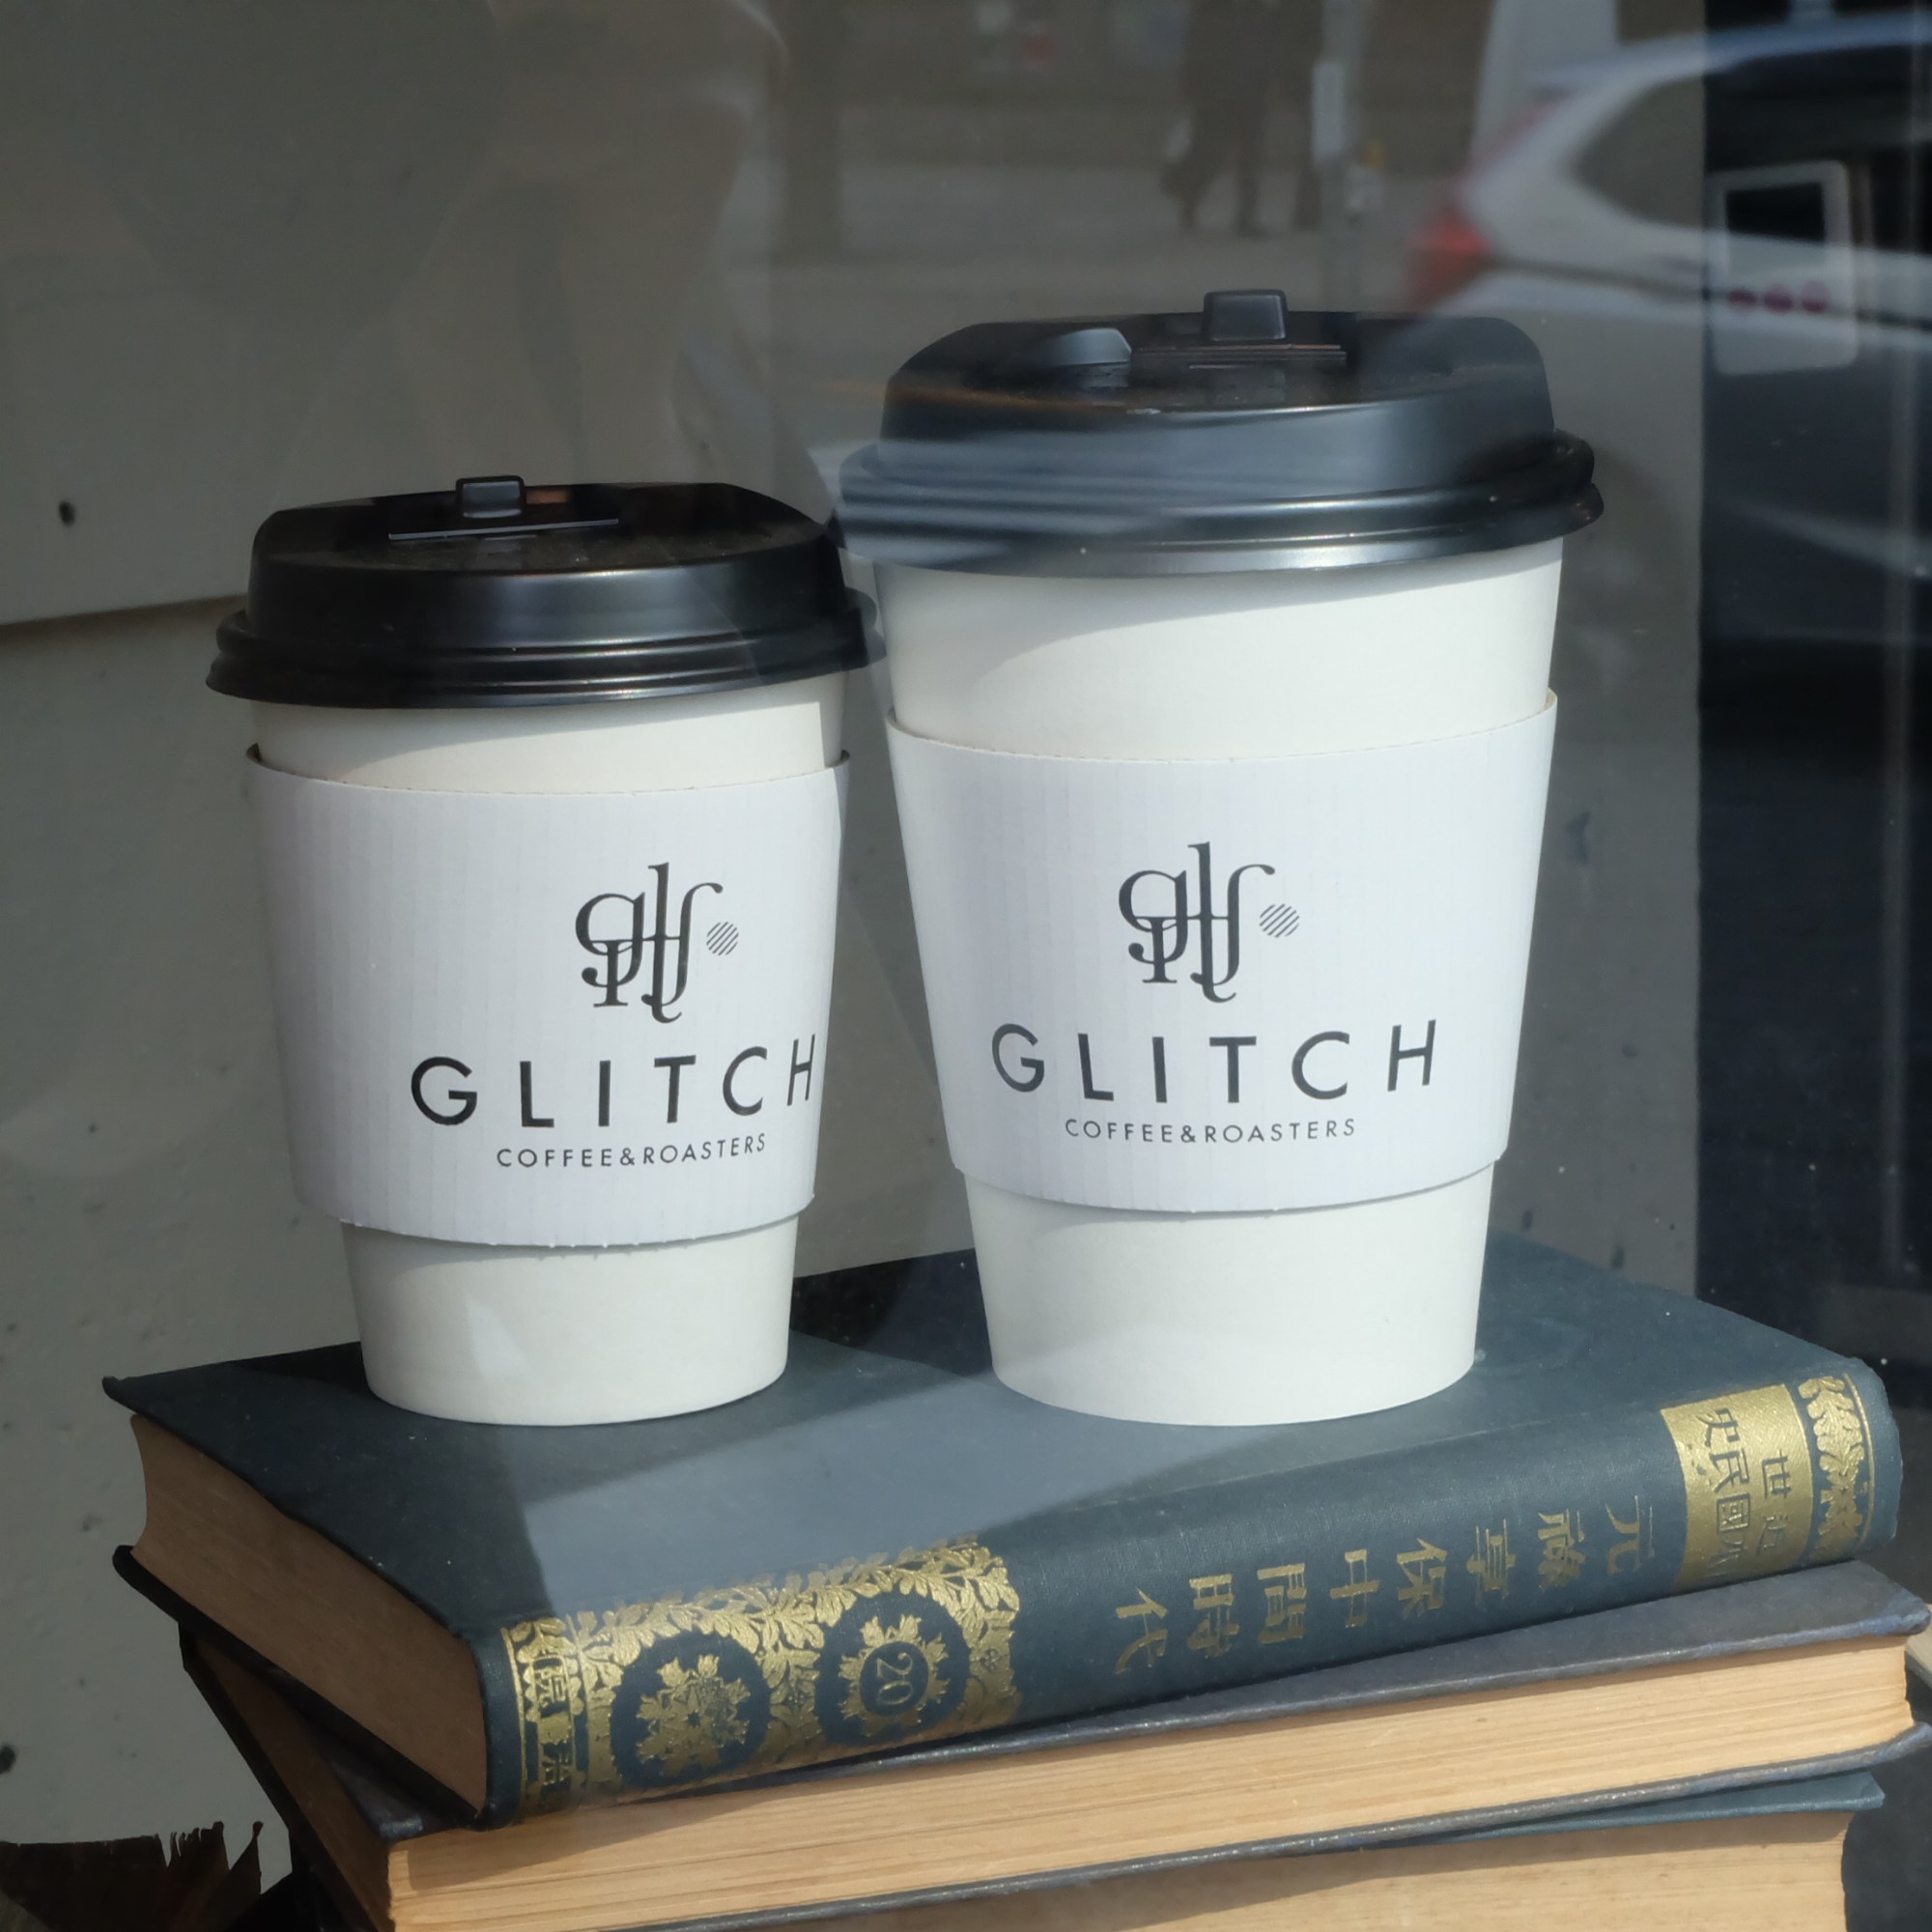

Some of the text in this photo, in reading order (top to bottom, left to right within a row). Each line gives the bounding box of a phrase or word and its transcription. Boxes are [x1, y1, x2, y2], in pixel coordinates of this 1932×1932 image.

[411, 1034, 816, 1126] GLITCH
[991, 1019, 1436, 1103] GLITCH
[496, 1132, 766, 1168] COFFEE&ROASTERS
[1065, 1118, 1356, 1144] COFFEE&ROASTERS
[875, 1652, 914, 1707] 20
